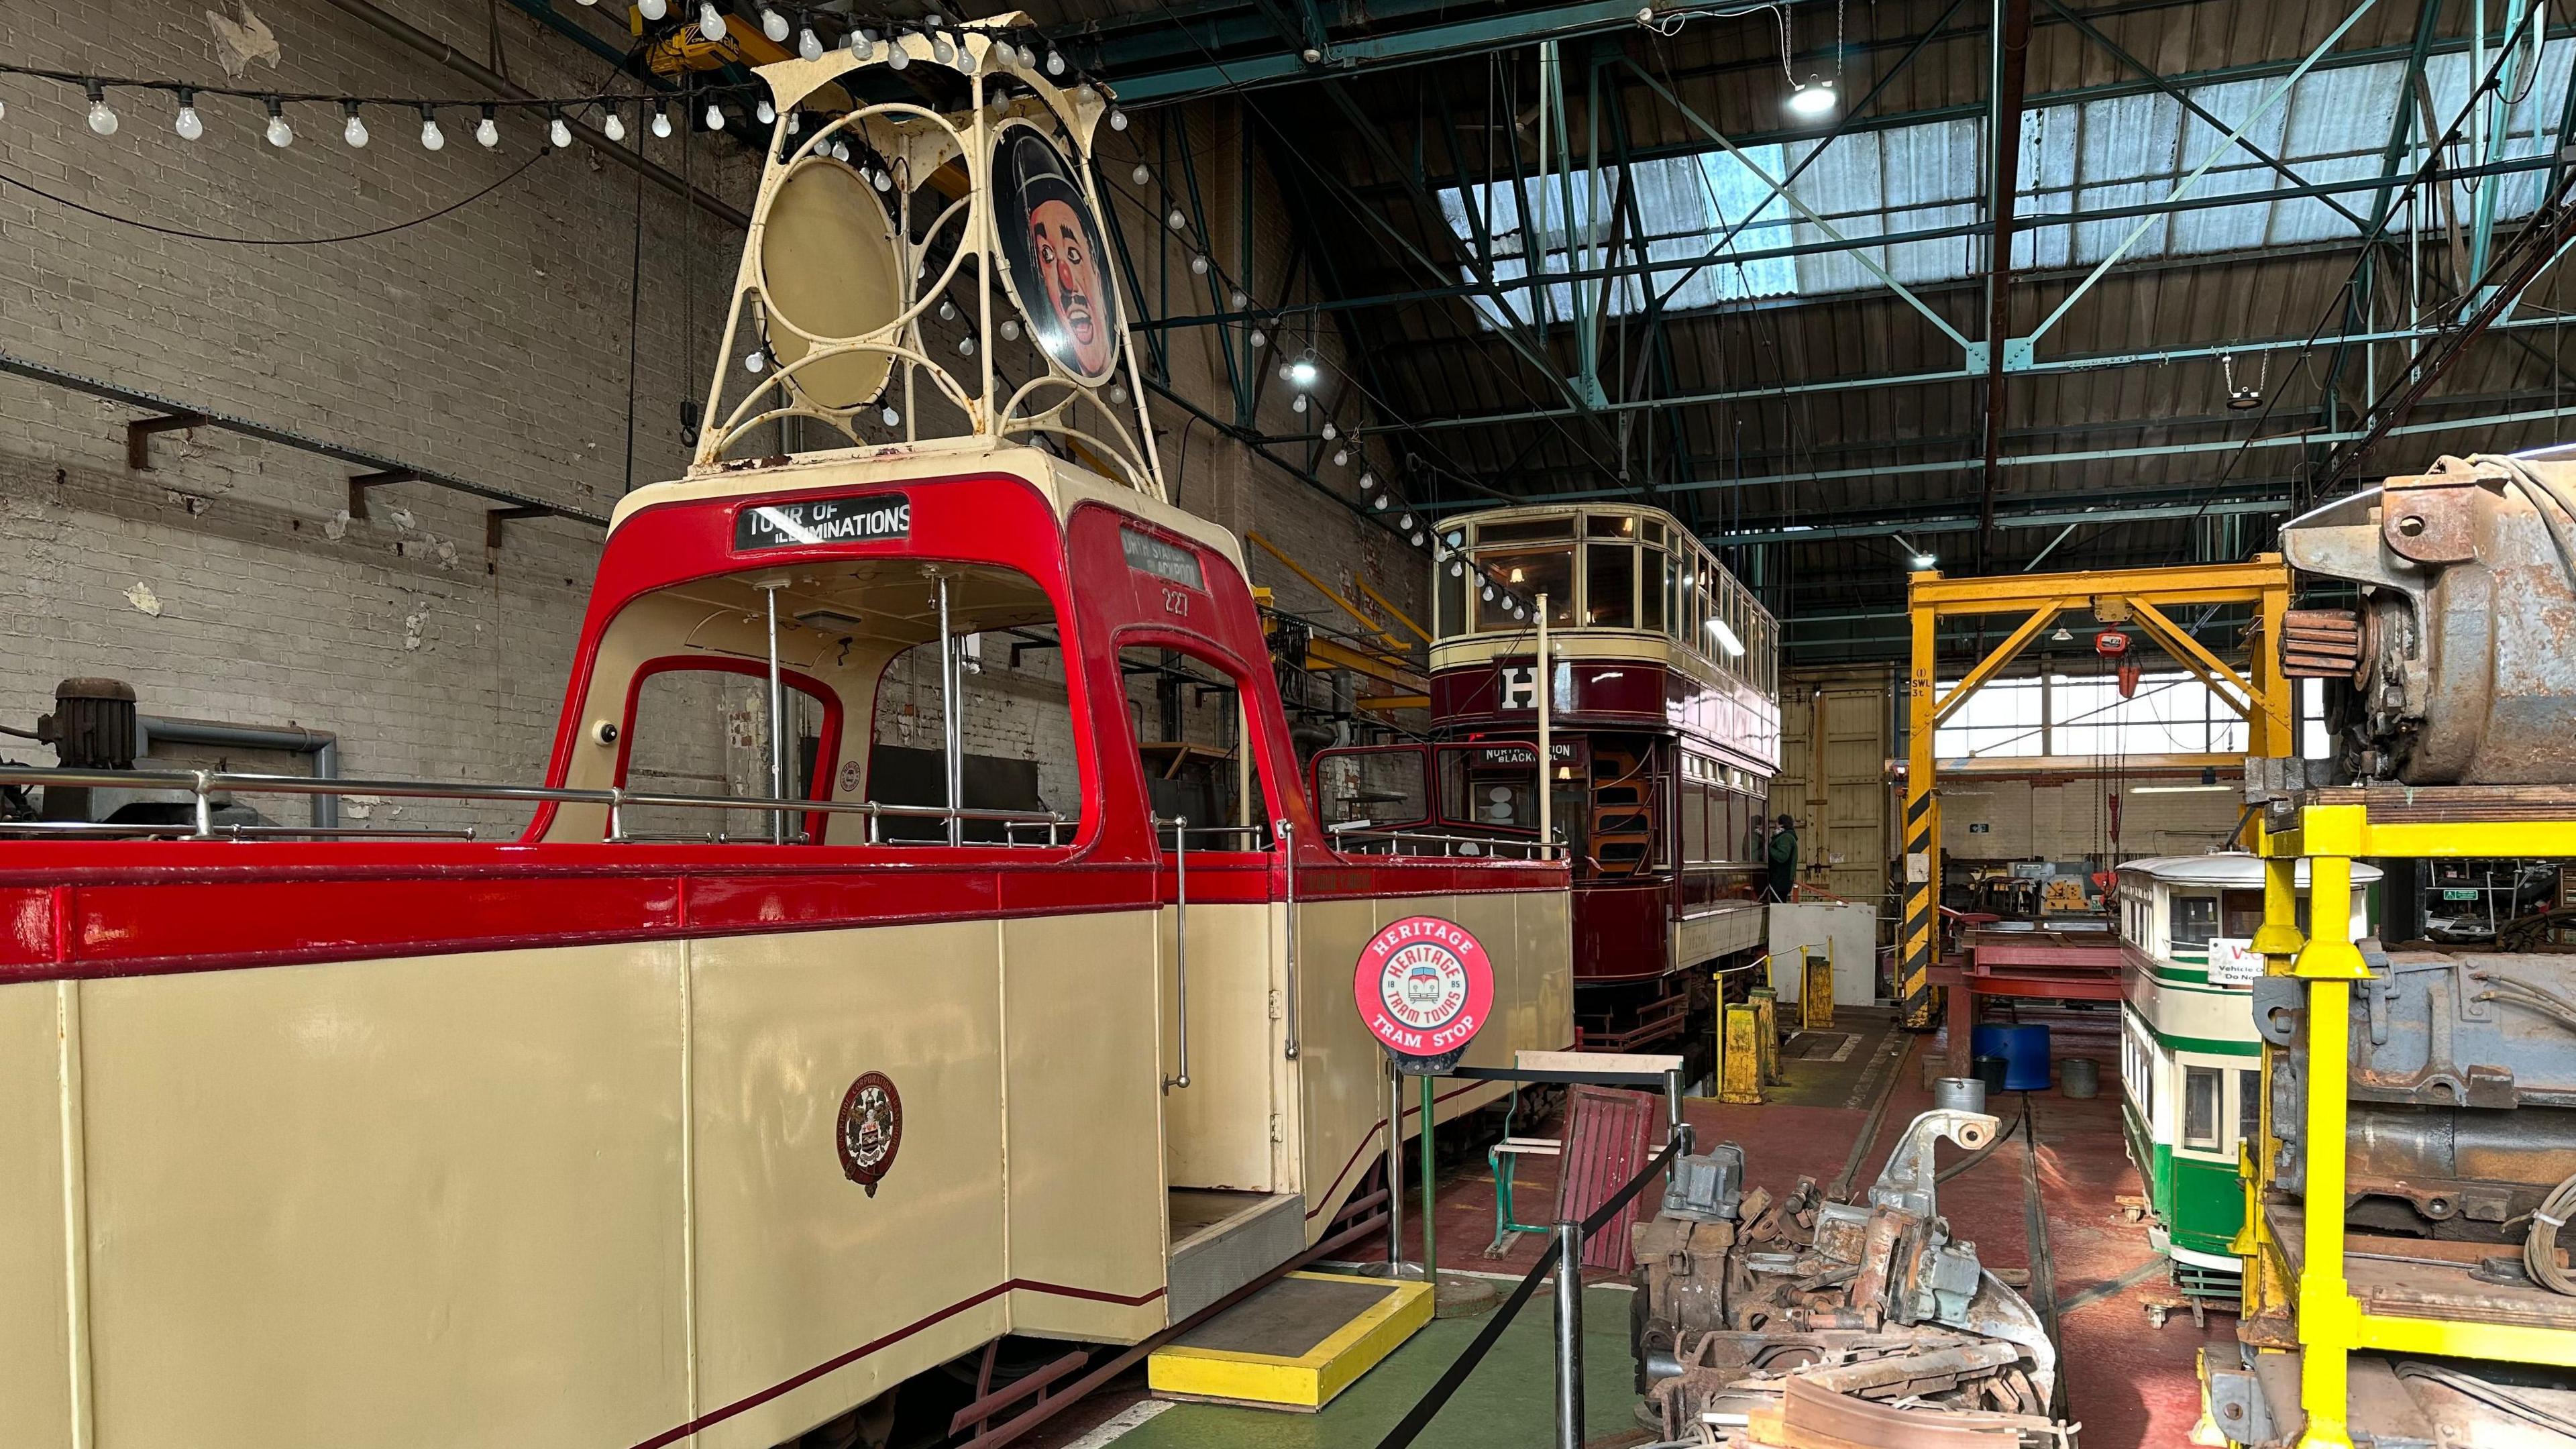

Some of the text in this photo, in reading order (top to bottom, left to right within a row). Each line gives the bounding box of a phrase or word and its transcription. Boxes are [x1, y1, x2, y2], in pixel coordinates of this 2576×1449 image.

[720, 36, 739, 54] ale
[749, 504, 838, 535] TOR OF
[775, 504, 910, 543] ILLMINATIONS
[1163, 588, 1188, 616] 227
[1502, 667, 1539, 709] H
[1912, 679, 1931, 688] SWL
[1373, 922, 1474, 957] HERITAGE
[1388, 947, 1460, 979] HERITAGE
[1387, 990, 1461, 1024] TRAM TOURS
[1373, 1013, 1474, 1048] TRAM STOP
[852, 1074, 892, 1095] CORPORATION
